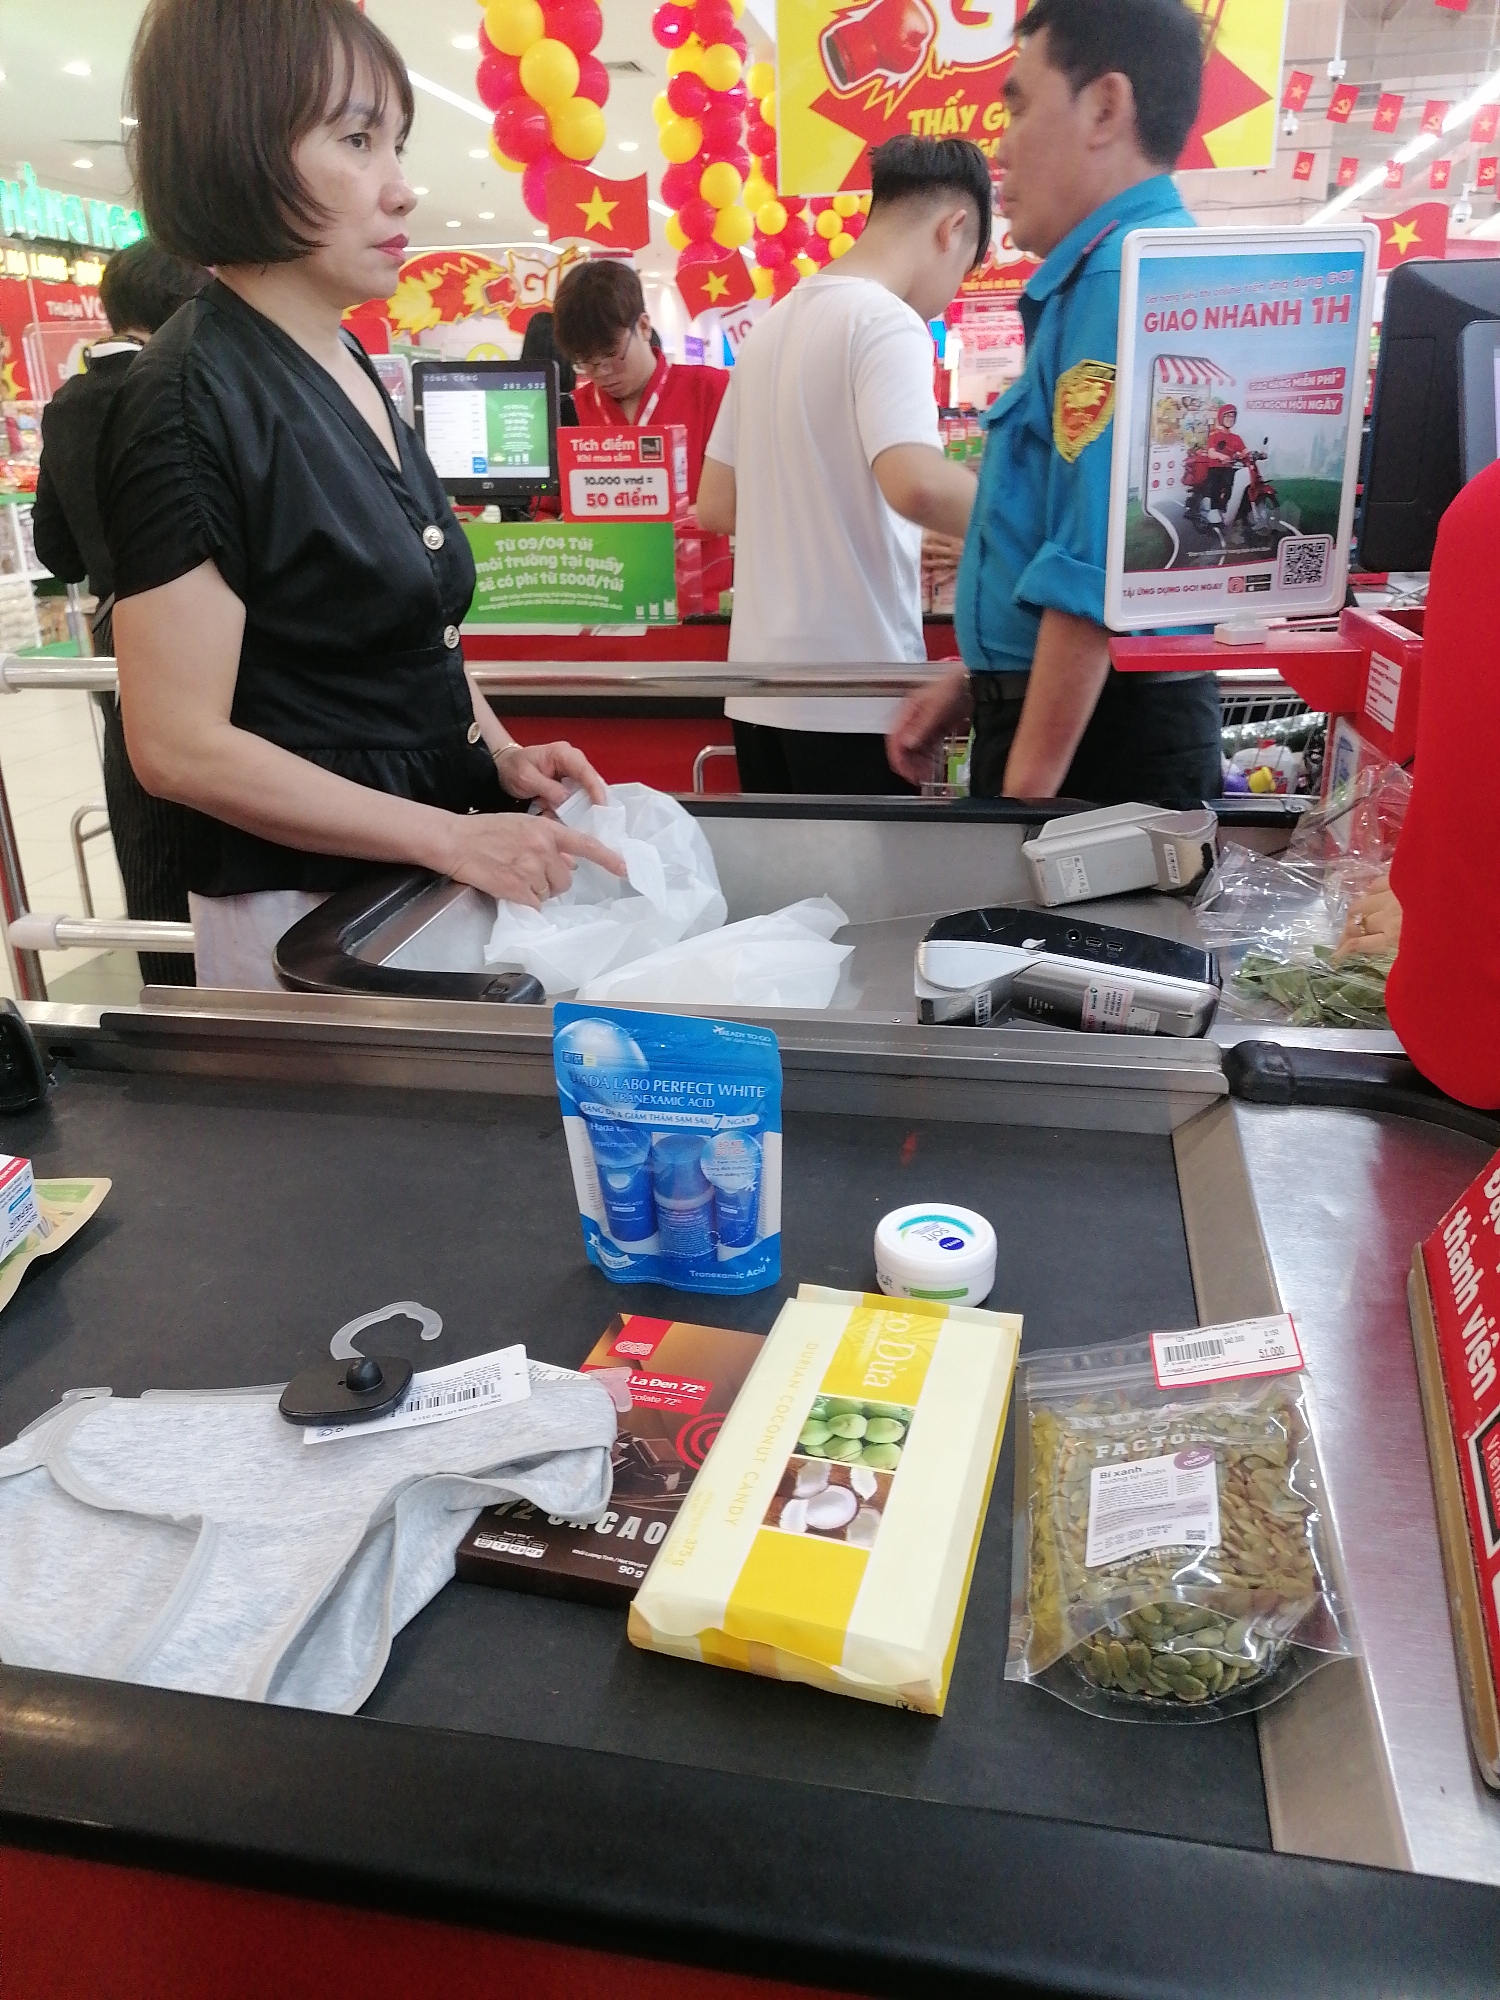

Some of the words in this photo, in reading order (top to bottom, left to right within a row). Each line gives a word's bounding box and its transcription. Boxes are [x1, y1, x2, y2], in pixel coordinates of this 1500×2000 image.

[907, 88, 979, 137] THẤY
[1326, 270, 1355, 284] GO!
[1144, 308, 1199, 333] GIAO
[1203, 299, 1301, 330] NHANH
[1311, 294, 1352, 325] 1H
[570, 438, 600, 452] Tích
[601, 434, 636, 451] điểm
[583, 475, 621, 486] 10.000
[623, 476, 644, 485] vnd
[586, 492, 609, 508] 50
[614, 487, 658, 507] điểm
[495, 539, 516, 553] Từ
[517, 536, 566, 551] 09/04
[568, 538, 594, 552] Túi
[504, 553, 558, 571] trường
[559, 553, 584, 570] tại
[497, 576, 515, 590] có
[515, 572, 539, 590] phí
[613, 1076, 650, 1092] LABO
[652, 1080, 715, 1096] PERFECT
[718, 1083, 766, 1098] WHITE
[613, 1092, 687, 1108] TRANEXAMIC
[688, 1097, 716, 1108] ACID
[694, 1116, 710, 1125] SAU
[712, 1114, 725, 1131] 7
[921, 1227, 950, 1242] soft
[1443, 1205, 1484, 1316] thành
[689, 1269, 745, 1279] Tranexamic
[745, 1264, 767, 1278] Acid
[1461, 1302, 1500, 1402] viên
[789, 1340, 820, 1391] DURIAN
[630, 1376, 648, 1386] La
[649, 1378, 678, 1390] Đen
[629, 1393, 662, 1405] colate
[754, 1393, 791, 1469] COCONUT
[1113, 1466, 1143, 1478] xanh
[723, 1470, 760, 1528] CANDY
[546, 1510, 669, 1546] CAO
[618, 1565, 635, 1575] 90
[634, 1570, 645, 1579] g
